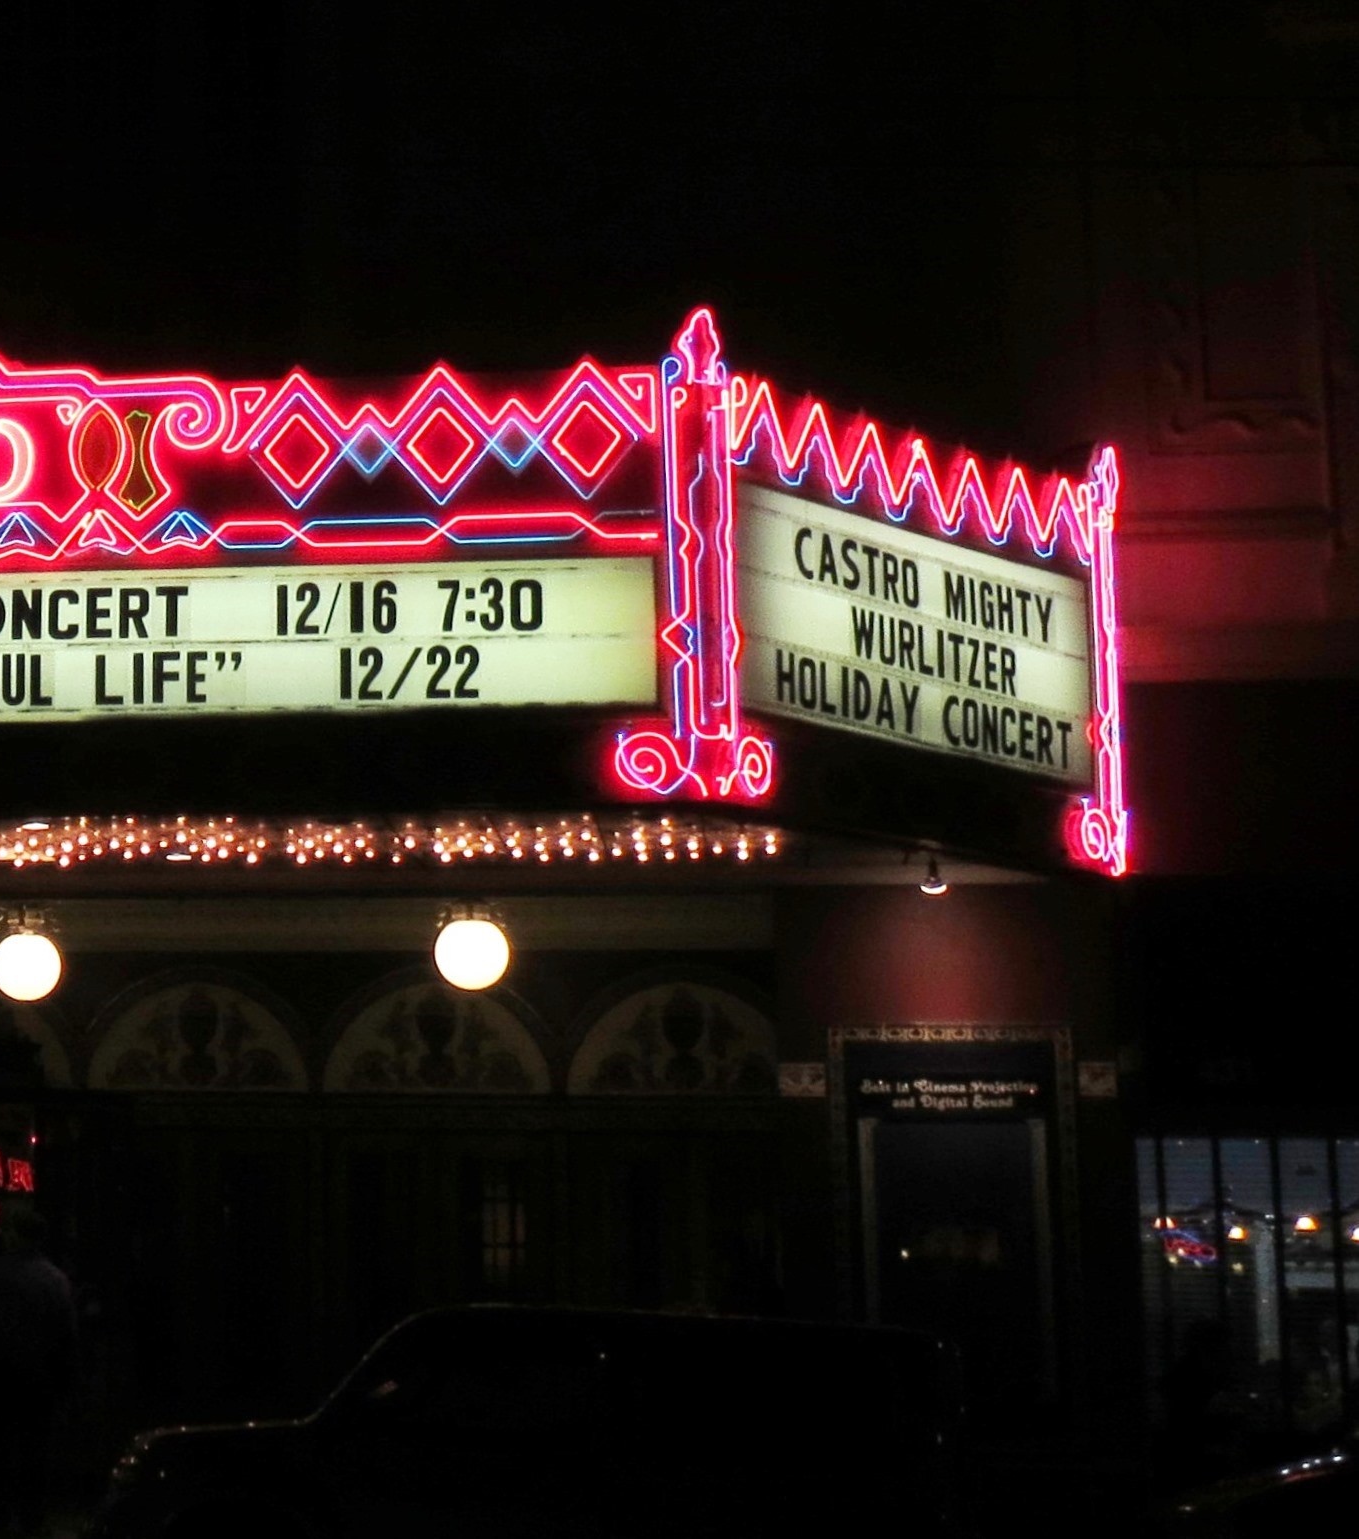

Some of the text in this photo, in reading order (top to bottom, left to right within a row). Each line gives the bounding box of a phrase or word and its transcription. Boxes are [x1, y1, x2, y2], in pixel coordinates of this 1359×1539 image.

[277, 580, 397, 636] 12/16
[438, 577, 543, 632] 7:30
[795, 527, 1053, 643] CASTRO MIGHTY
[340, 645, 480, 700] 12/22
[852, 605, 1017, 696] WURLITZER
[775, 648, 1072, 770] HOLIDAY CONCERT
[913, 1078, 967, 1094] Cinema
[919, 1095, 968, 1111] Digital
